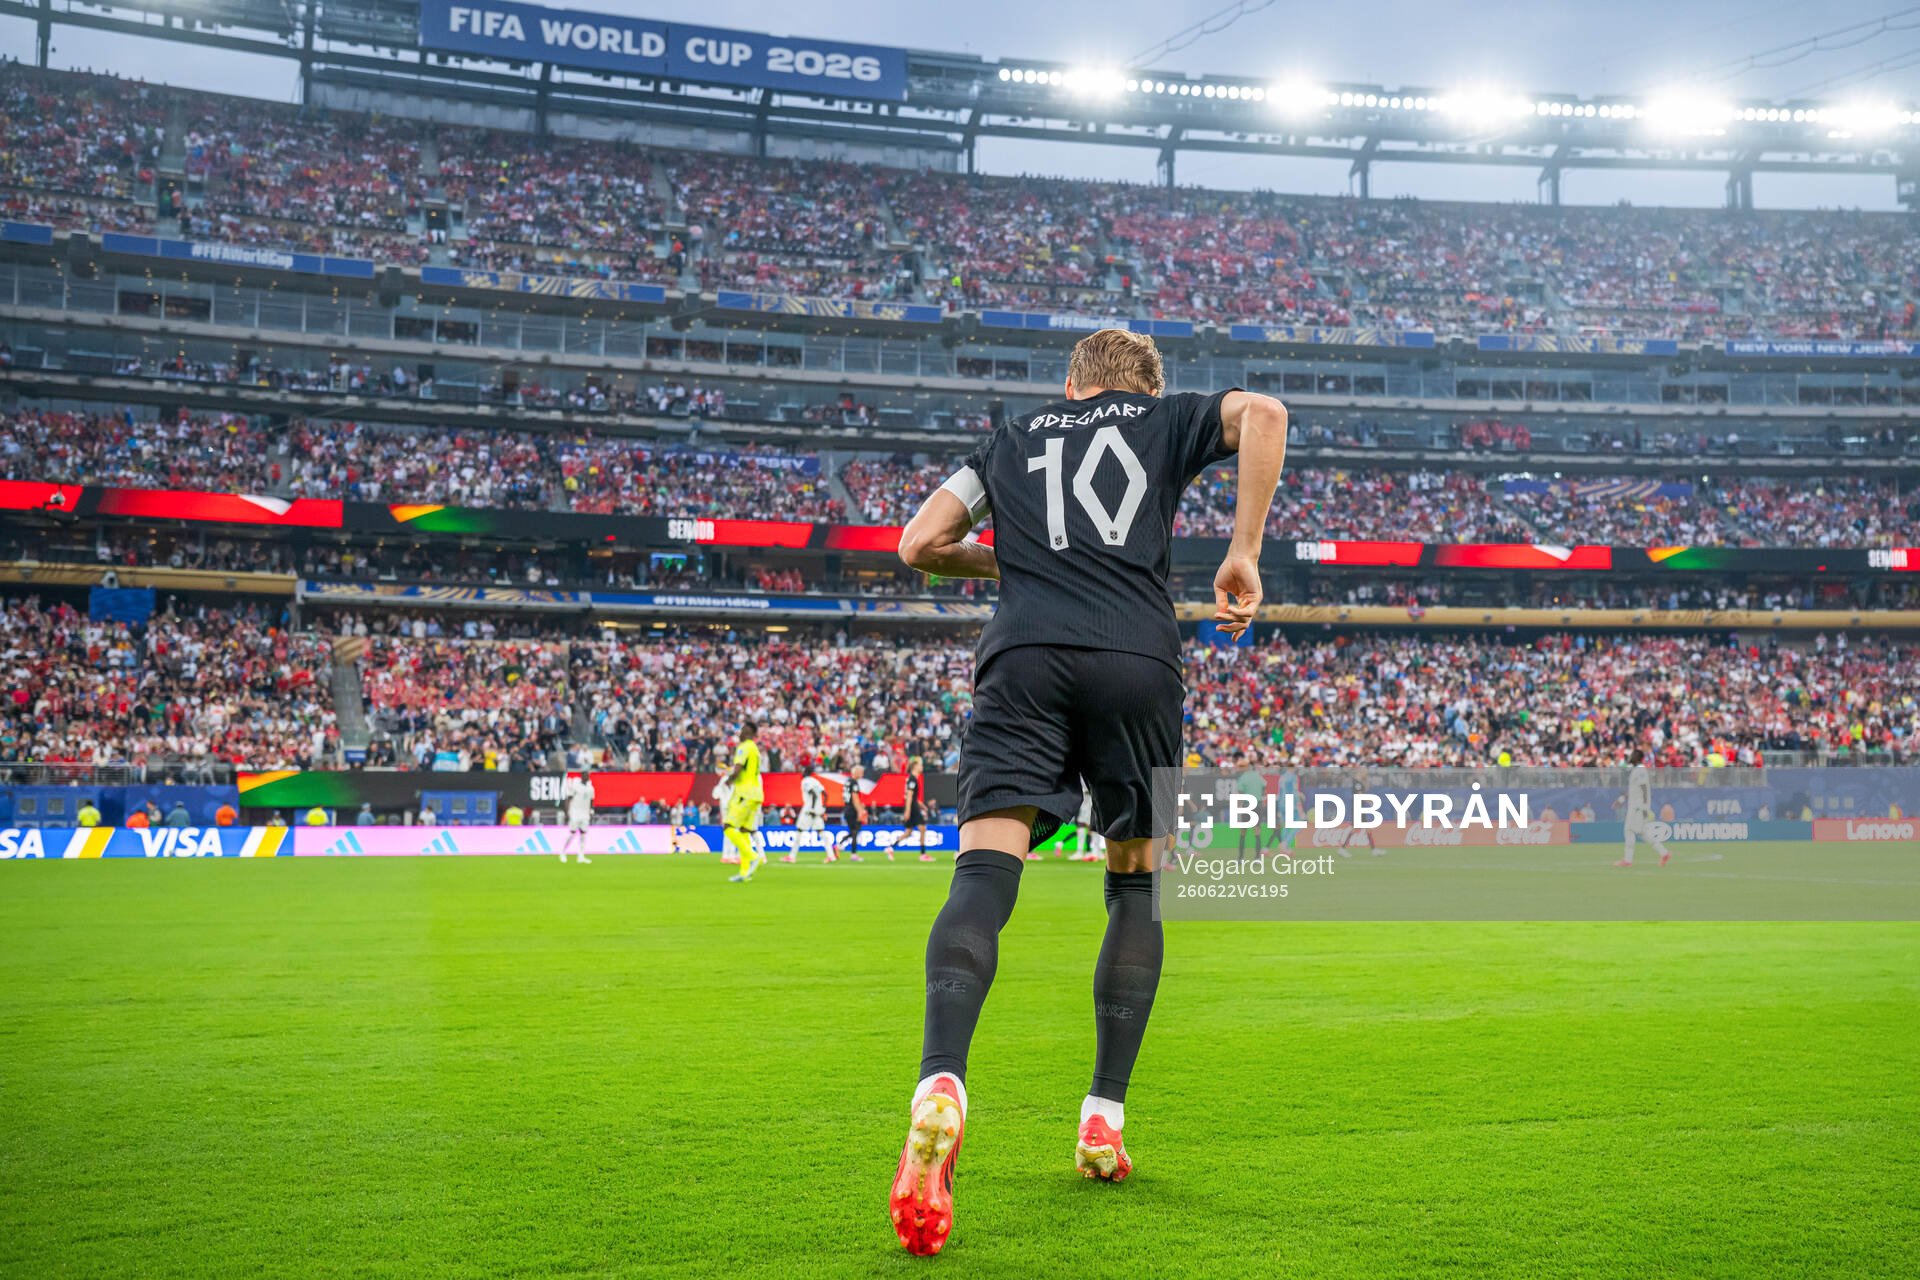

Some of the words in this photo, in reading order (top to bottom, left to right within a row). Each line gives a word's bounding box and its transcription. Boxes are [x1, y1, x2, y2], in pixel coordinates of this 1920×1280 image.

[449, 6, 525, 42] FIFA
[541, 19, 666, 58] WORLD
[685, 37, 752, 68] CUP
[767, 47, 882, 83] 2026
[1733, 342, 1769, 353] NEW
[1772, 343, 1813, 354] YORK
[1817, 343, 1850, 354] NEW
[1028, 425, 1147, 551] 10
[1706, 799, 1743, 815] FIFA
[766, 830, 835, 848] WORLD
[1673, 823, 1749, 840] HYUNDAI
[1846, 820, 1915, 841] Lenovo
[133, 827, 223, 857] VISA
